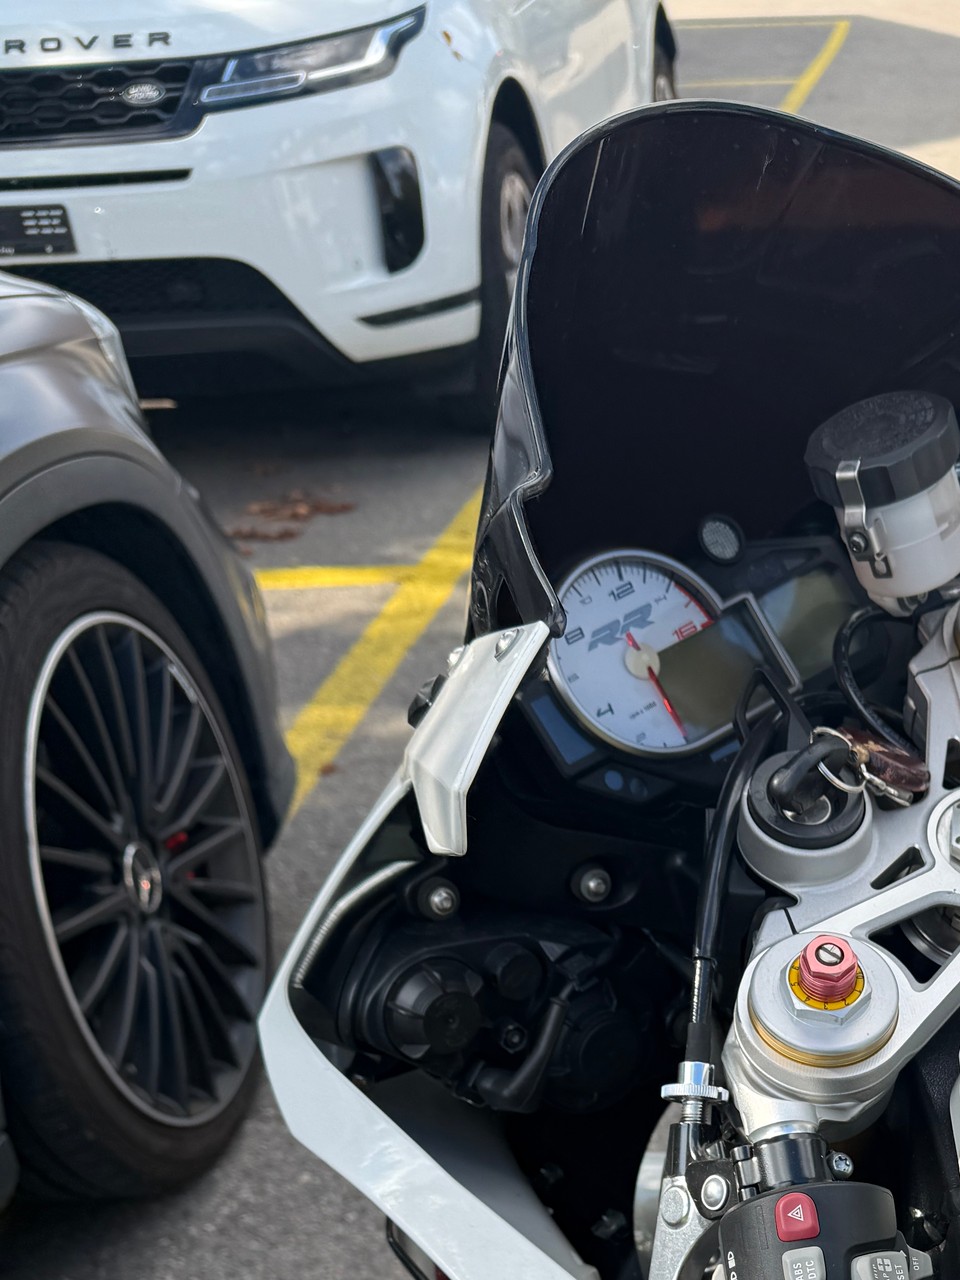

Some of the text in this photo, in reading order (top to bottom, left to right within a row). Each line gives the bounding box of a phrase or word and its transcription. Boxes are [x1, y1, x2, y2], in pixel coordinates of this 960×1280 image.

[4, 32, 171, 54] ROVER
[608, 581, 635, 601] 12
[564, 627, 585, 645] 8
[588, 602, 655, 652] RR
[672, 621, 698, 641] 16
[596, 702, 615, 718] 4
[793, 1262, 804, 1280] ABS
[805, 1260, 817, 1280] DTC
[894, 1264, 905, 1280] SET
[912, 1256, 920, 1271] OFF
